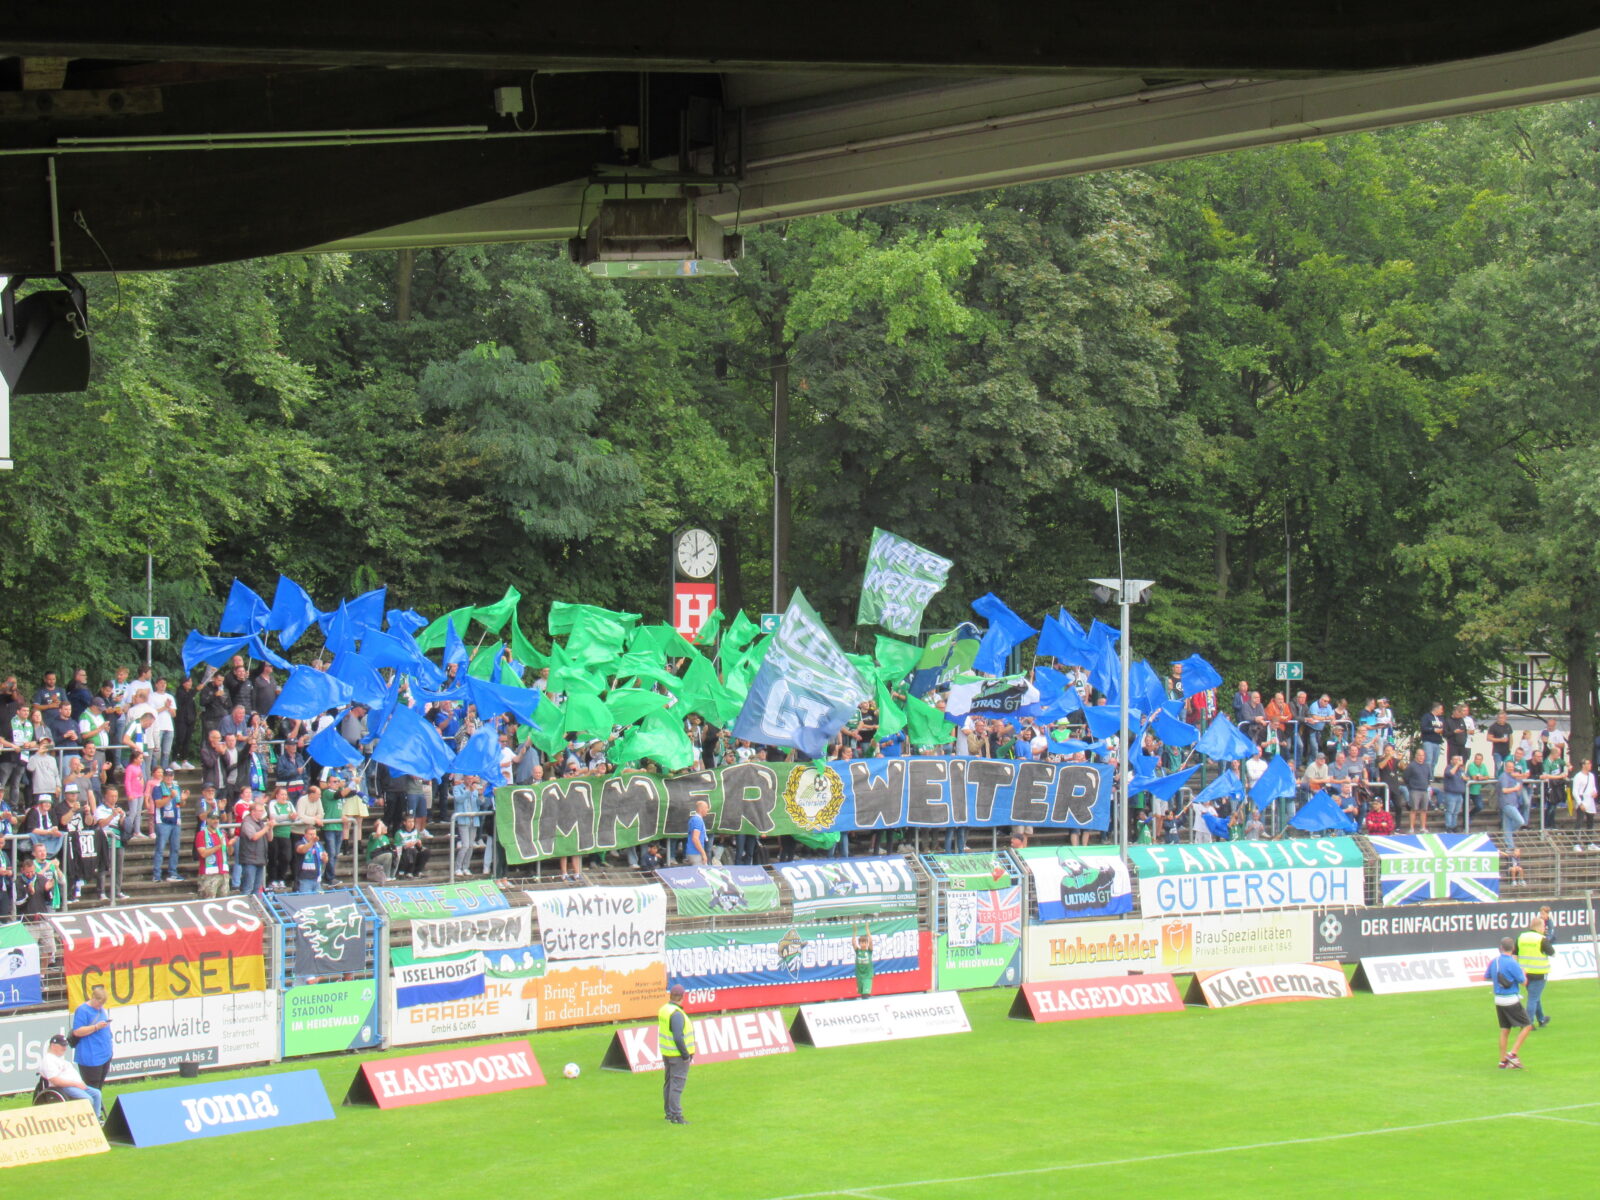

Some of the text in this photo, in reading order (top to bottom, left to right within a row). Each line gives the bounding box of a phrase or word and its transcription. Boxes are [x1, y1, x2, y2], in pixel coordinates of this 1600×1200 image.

[760, 669, 830, 738] GT
[1004, 697, 1021, 711] GT
[511, 758, 1101, 860] IMMER WEITER
[1146, 838, 1344, 874] FANATICS
[1389, 857, 1492, 874] LEICESTER
[780, 858, 913, 901] GT LEBT
[1156, 868, 1349, 912] GÜTERSLOH
[382, 883, 505, 914] RHEDA
[565, 892, 636, 919] Aktive
[1064, 890, 1112, 906] ULTRAS GT
[50, 899, 262, 952] FANATICS
[416, 916, 523, 950] SUNDERN
[1195, 927, 1293, 944] BrauSpezialitäten
[1360, 918, 1390, 937] DER
[1391, 914, 1474, 935] EINFACHSTE
[1475, 912, 1508, 931] WEG
[542, 925, 665, 953] Gütersloher
[1049, 933, 1159, 967] Hohenfelder
[666, 929, 919, 978] VORWÄRTS GÜTESLOH
[945, 948, 982, 959] STADION
[945, 957, 1005, 969] IM HEIDEWALD
[81, 949, 251, 1005] GÜTSEL
[402, 958, 478, 983] ISSELHORST
[291, 992, 349, 1006] OHLENDORF
[580, 978, 614, 998] Farbe
[688, 990, 716, 1005] GWG
[1033, 982, 1173, 1013] HAGEDORN
[1207, 970, 1342, 1007] Kleinemas
[291, 1004, 334, 1018] STADION
[409, 1000, 500, 1025] GRABKE
[544, 999, 621, 1022] in dein Leben
[815, 1012, 881, 1028] PANNHORST
[892, 1005, 956, 1020] PANNHORST
[113, 1018, 211, 1044] chtsanwälte
[291, 1015, 360, 1032] IM HEIDEWALD
[431, 1022, 451, 1034] GmbH
[453, 1022, 458, 1032] &
[168, 1055, 183, 1066] von
[185, 1052, 191, 1063] A
[192, 1050, 205, 1062] bis
[207, 1049, 214, 1061] Z
[374, 1052, 533, 1098] HAGEDORN
[0, 1111, 95, 1141] Kollmeyer
